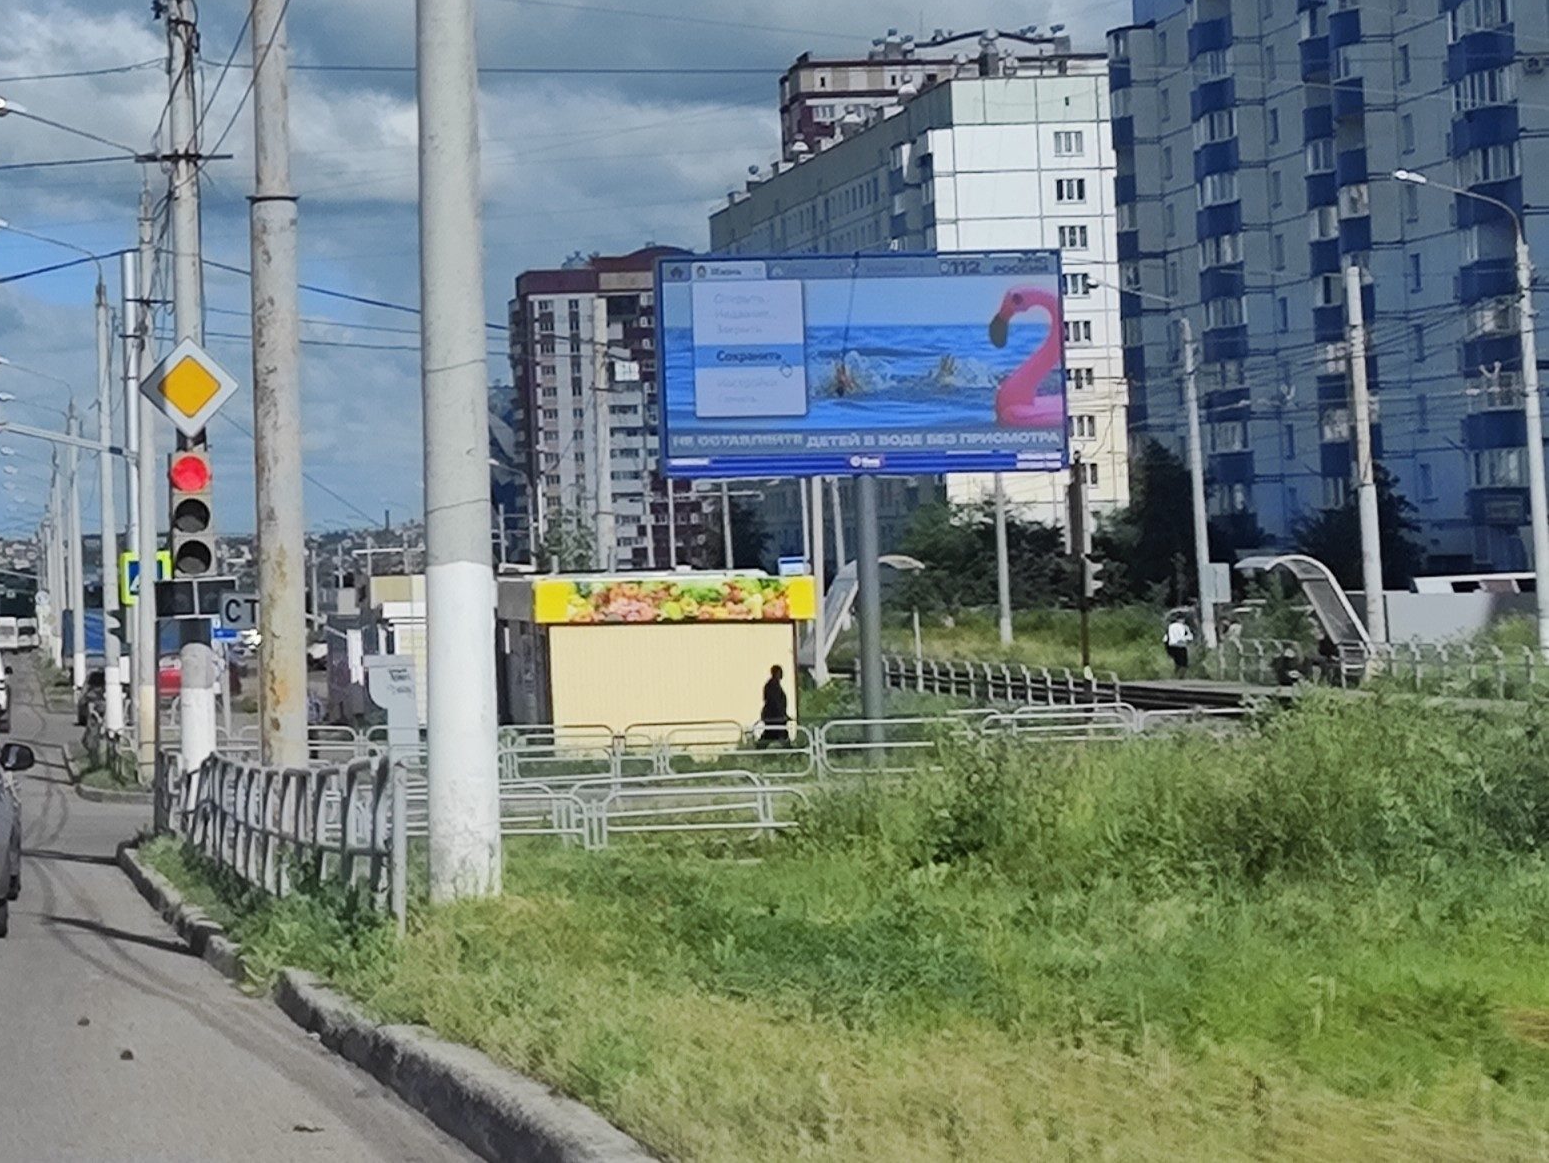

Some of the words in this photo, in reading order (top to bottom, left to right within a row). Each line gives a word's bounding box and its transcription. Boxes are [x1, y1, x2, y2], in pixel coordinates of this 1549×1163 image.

[806, 432, 861, 448] ДЕТЕЙ
[863, 435, 876, 446] В
[878, 434, 923, 446] ВОДЕ
[927, 434, 957, 445] БЕЗ
[960, 431, 1060, 445] ПРИСМОТРА
